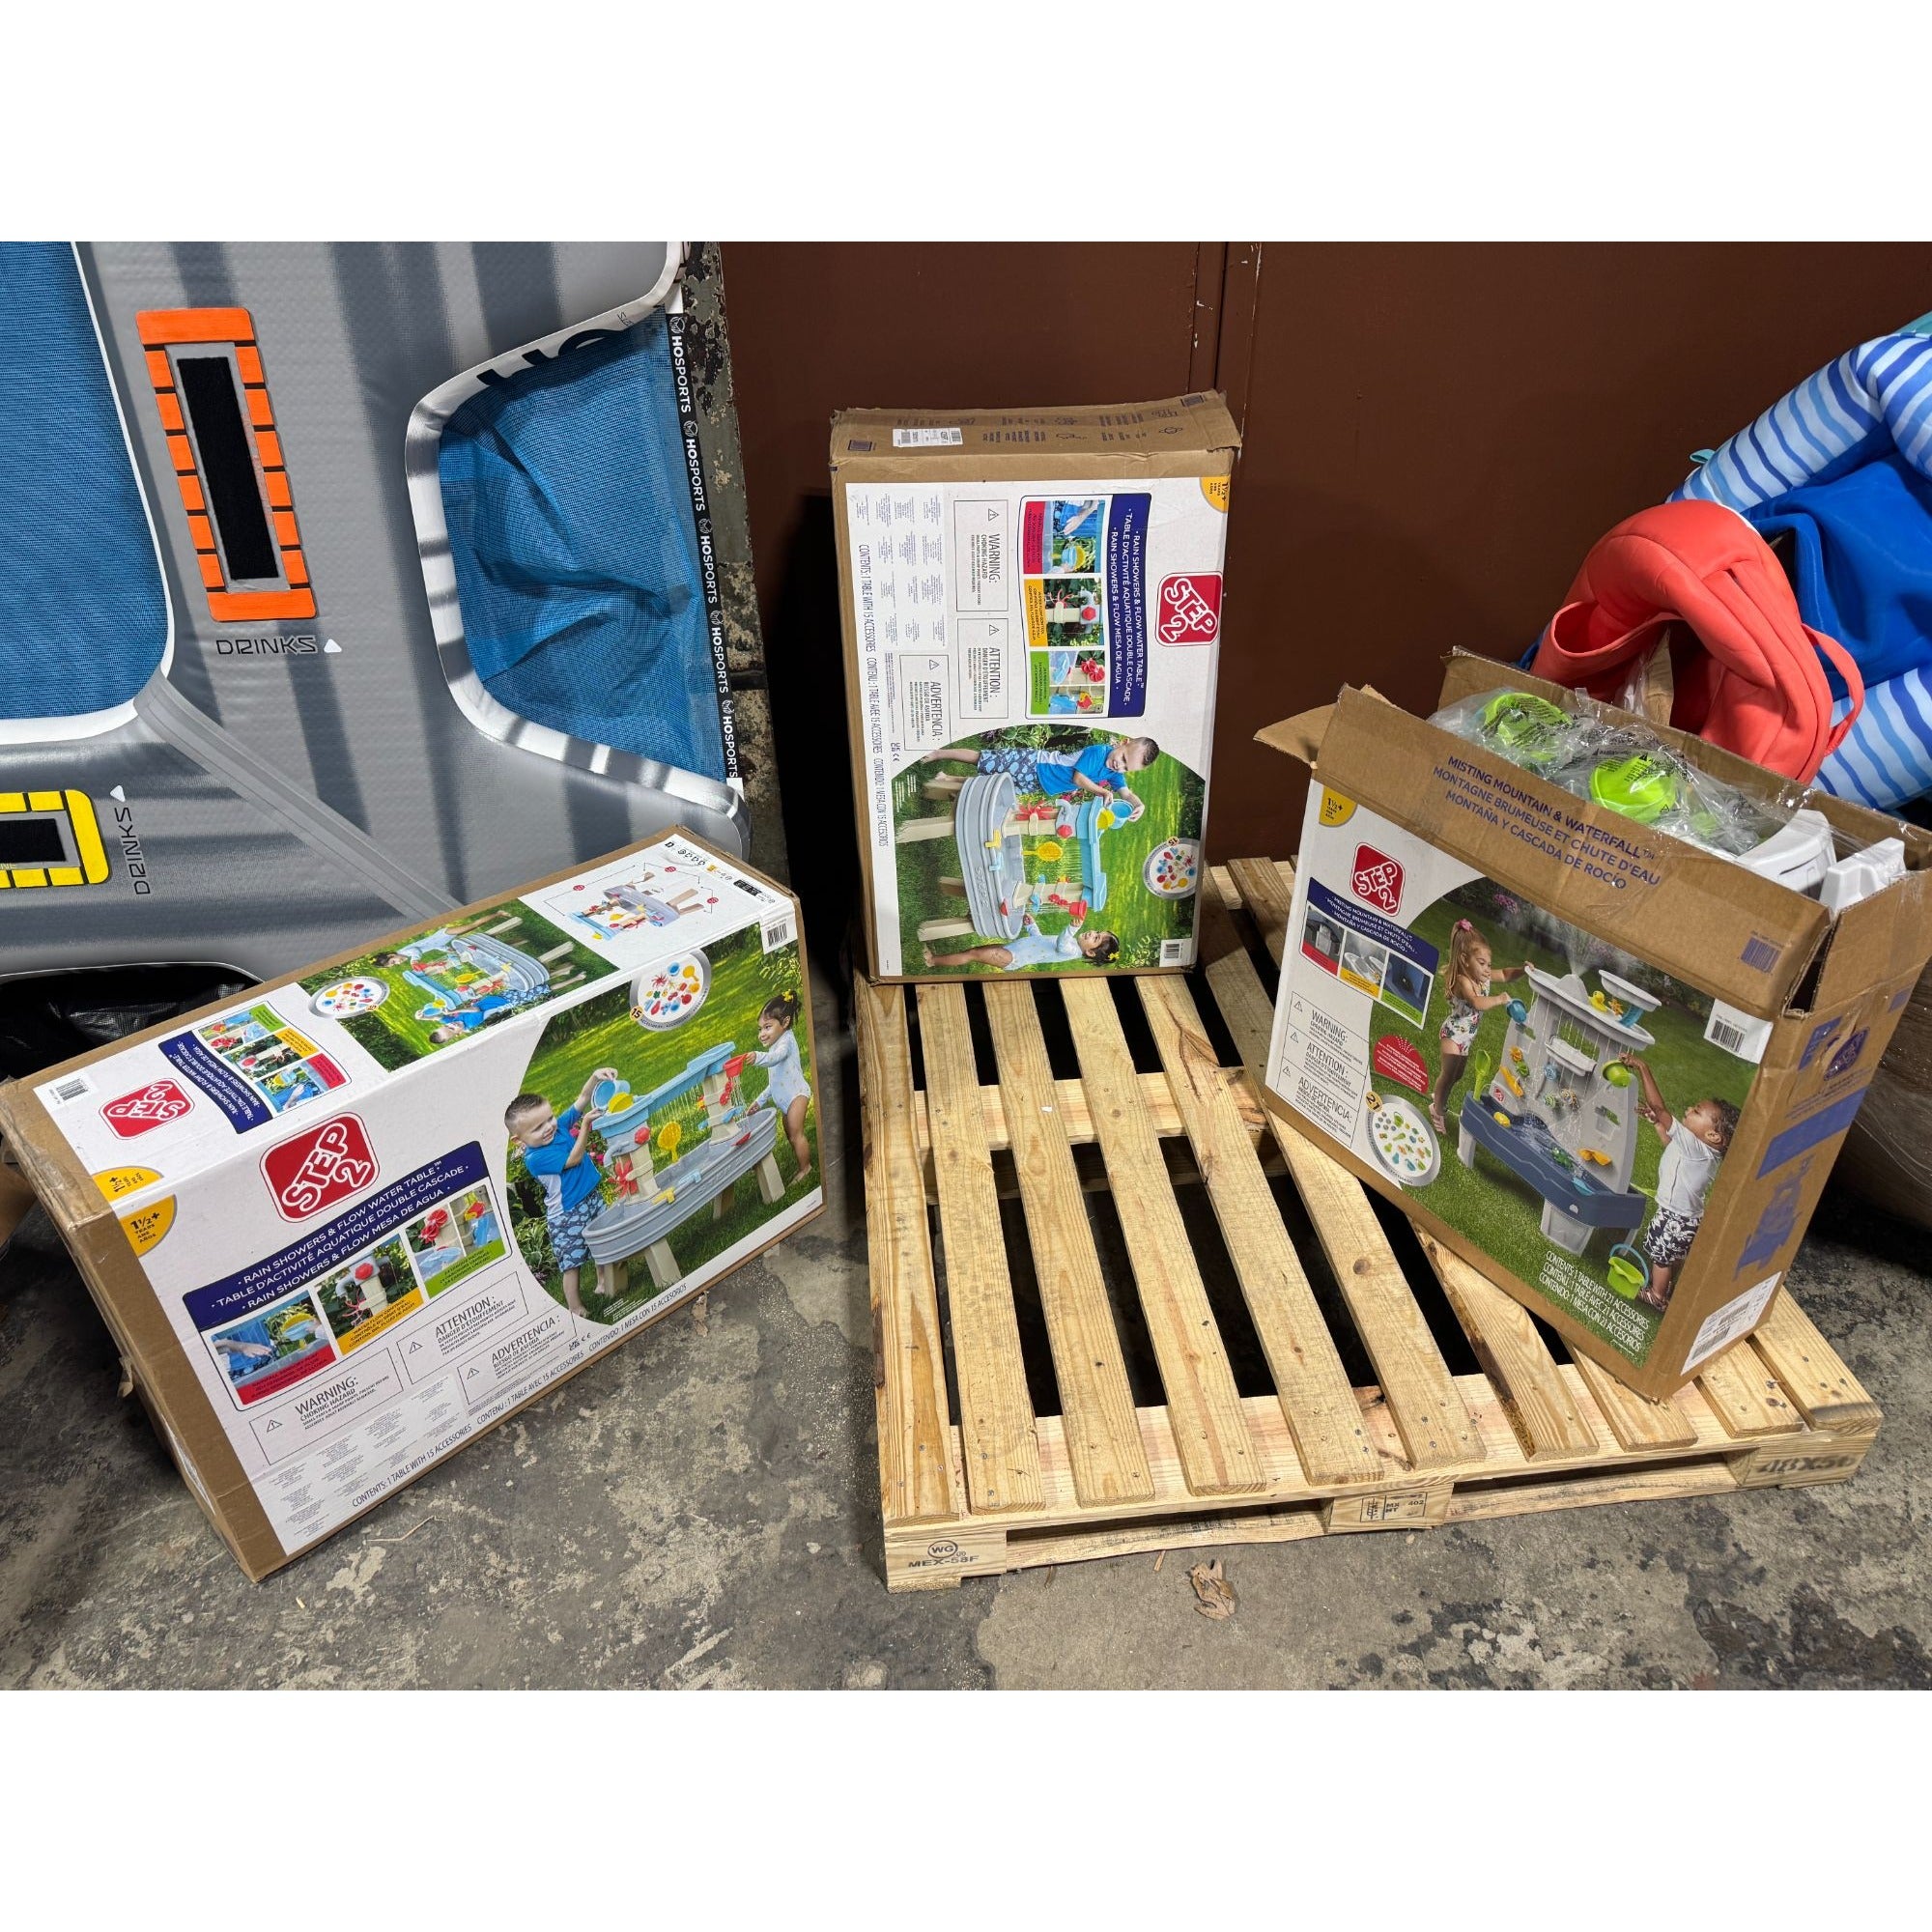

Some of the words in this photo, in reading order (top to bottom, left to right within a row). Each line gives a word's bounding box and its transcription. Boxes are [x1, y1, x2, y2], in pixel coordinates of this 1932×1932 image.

[671, 336, 691, 412] HOSPORTS
[685, 439, 705, 511] HOSPORTS
[1122, 512, 1131, 539] TABLE
[700, 535, 717, 604] HOSPORTS
[988, 533, 1000, 582] WARNING:
[1122, 541, 1130, 585] D'ACTIVITÉ
[1122, 586, 1132, 633] AQUATIQUE
[1160, 614, 1188, 641] 2
[1164, 578, 1217, 634] STEP
[216, 637, 316, 654] DRINKS
[711, 627, 728, 694] HOSPORTS
[1115, 650, 1122, 661] DE
[1123, 667, 1132, 701] CASCADE
[722, 716, 738, 778] HOSPORTS
[1447, 756, 1492, 784] MISTING
[1492, 779, 1551, 815] MOUNTAIN
[1552, 810, 1563, 821] &
[1432, 766, 1493, 803] MONTAGNE
[1492, 797, 1552, 835] BRUMEUSE
[1553, 830, 1569, 842] ET
[1570, 838, 1616, 865] CHUTE
[1618, 860, 1661, 887] D'EAU
[1445, 790, 1500, 825] MONTAÑA
[1499, 818, 1510, 830] Y
[1509, 823, 1563, 860] CASCADA
[1563, 853, 1582, 868] DE
[1583, 862, 1627, 890] ROCÍO
[114, 808, 150, 895] DRINKS
[1354, 861, 1397, 895] STEP
[1378, 887, 1397, 910] 2
[631, 1008, 642, 1019] 15
[107, 1100, 186, 1122] STEP
[1366, 1094, 1379, 1110] 21
[282, 1122, 348, 1211] STEP
[332, 1158, 371, 1188] 2
[216, 1285, 255, 1307] TABLE
[255, 1251, 314, 1290] D'ACTIVITÉ
[314, 1213, 376, 1257] AQUATIQUE
[375, 1188, 417, 1218] DOUBLE
[416, 1164, 465, 1193] CASCADE
[242, 1264, 270, 1284] RAIN
[270, 1232, 327, 1269] SHOWERS
[327, 1226, 336, 1236] &
[336, 1206, 366, 1230] FLOW
[366, 1183, 404, 1210] WATER
[246, 1289, 275, 1308] RAIN
[275, 1257, 330, 1293] SHOWERS
[329, 1252, 340, 1262] &
[340, 1232, 371, 1255] FLOW
[370, 1213, 399, 1235] MESA
[399, 1204, 414, 1217] DE
[413, 1187, 444, 1208] AGUA
[1613, 1298, 1649, 1329] ACCESSORIES
[294, 1374, 358, 1415] WARNING:
[328, 1387, 356, 1406] HAZARD
[350, 1479, 388, 1508] CONTENTS:
[390, 1463, 412, 1482] TABLE
[409, 1454, 427, 1469] WITH
[908, 1555, 980, 1568] MEX-58F
